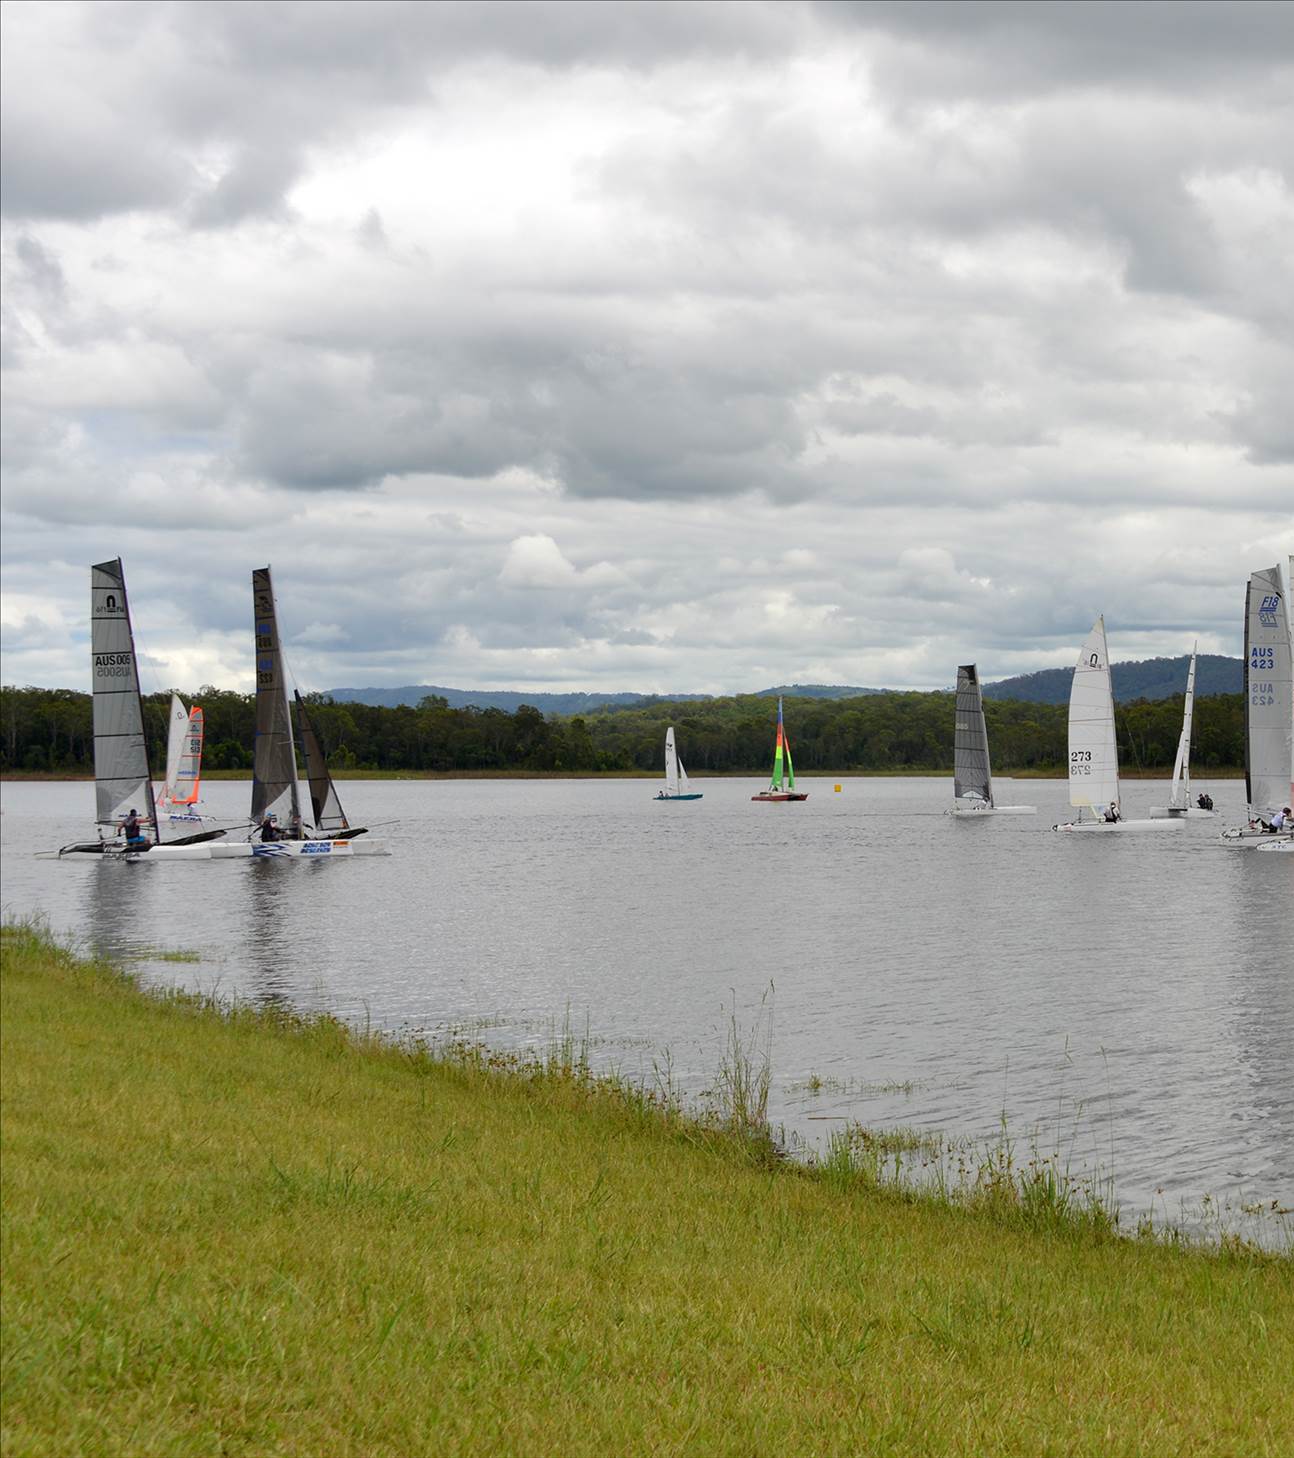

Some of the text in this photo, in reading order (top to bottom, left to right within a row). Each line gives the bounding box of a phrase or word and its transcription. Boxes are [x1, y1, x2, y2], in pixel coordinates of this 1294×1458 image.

[1261, 596, 1279, 608] F18
[1252, 647, 1273, 657] AUS
[1251, 659, 1274, 669] 423
[1071, 751, 1092, 762] 273
